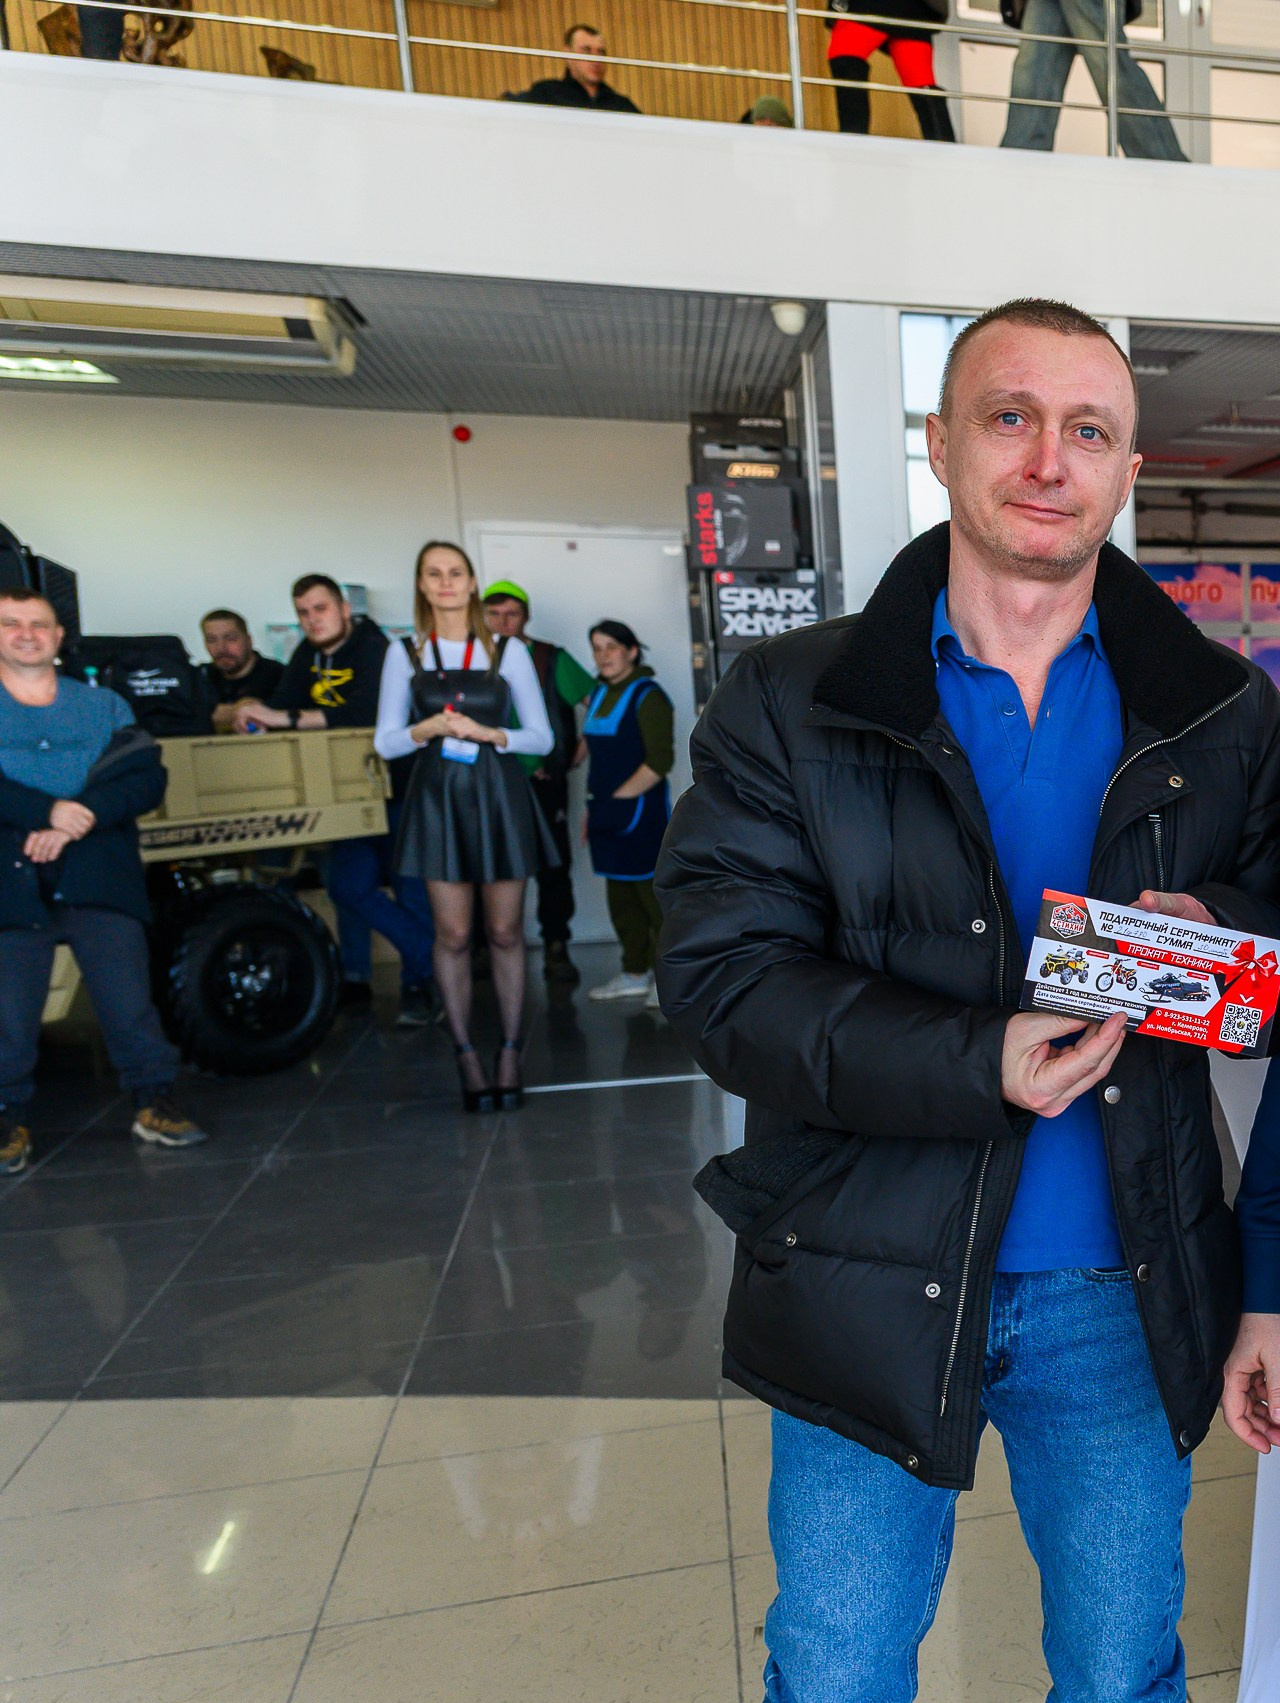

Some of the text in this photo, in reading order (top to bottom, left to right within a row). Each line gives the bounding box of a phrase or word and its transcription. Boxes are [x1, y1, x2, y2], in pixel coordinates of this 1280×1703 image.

[694, 491, 718, 565] starks
[718, 586, 817, 612] SPARX
[1099, 911, 1169, 933] ПОДАРОЧНЫЙ
[1170, 926, 1237, 949] СЕРТИФИКАТ
[1156, 935, 1193, 950] СУММА
[1127, 944, 1168, 960] ПРОКАТ
[1170, 953, 1214, 970] ТЕХНИКИ
[1036, 990, 1049, 998] Дата
[1164, 1011, 1210, 1026] 8-923-531-11-22
[1177, 1022, 1208, 1034] Кемерово,
[1193, 1032, 1206, 1040] 71/1
